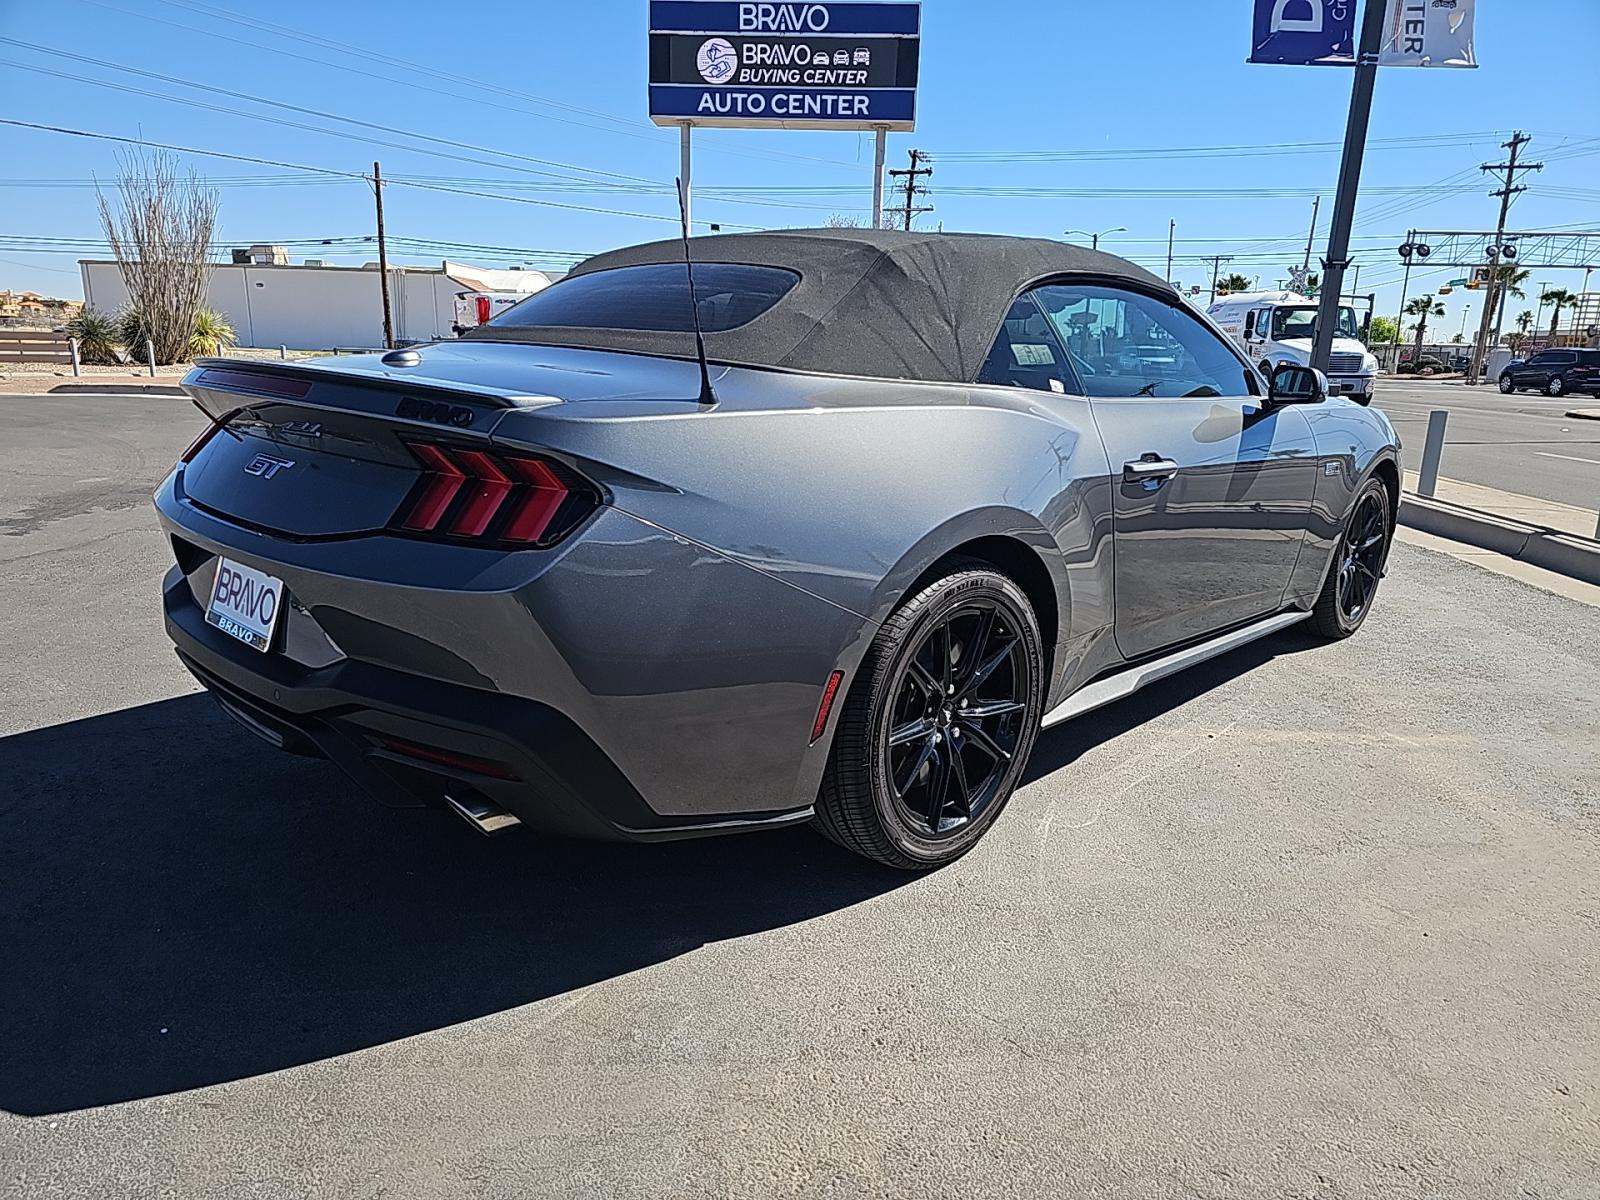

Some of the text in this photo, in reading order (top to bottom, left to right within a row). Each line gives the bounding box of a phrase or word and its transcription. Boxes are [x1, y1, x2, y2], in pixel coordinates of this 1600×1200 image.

[739, 4, 830, 31] BRAVO
[743, 44, 811, 65] BRAVO
[739, 69, 868, 85] BUYING CENTER
[698, 93, 870, 115] AUTO CENTER
[245, 452, 296, 480] GT
[216, 566, 276, 626] BRAVO
[218, 617, 254, 643] BRAVO
